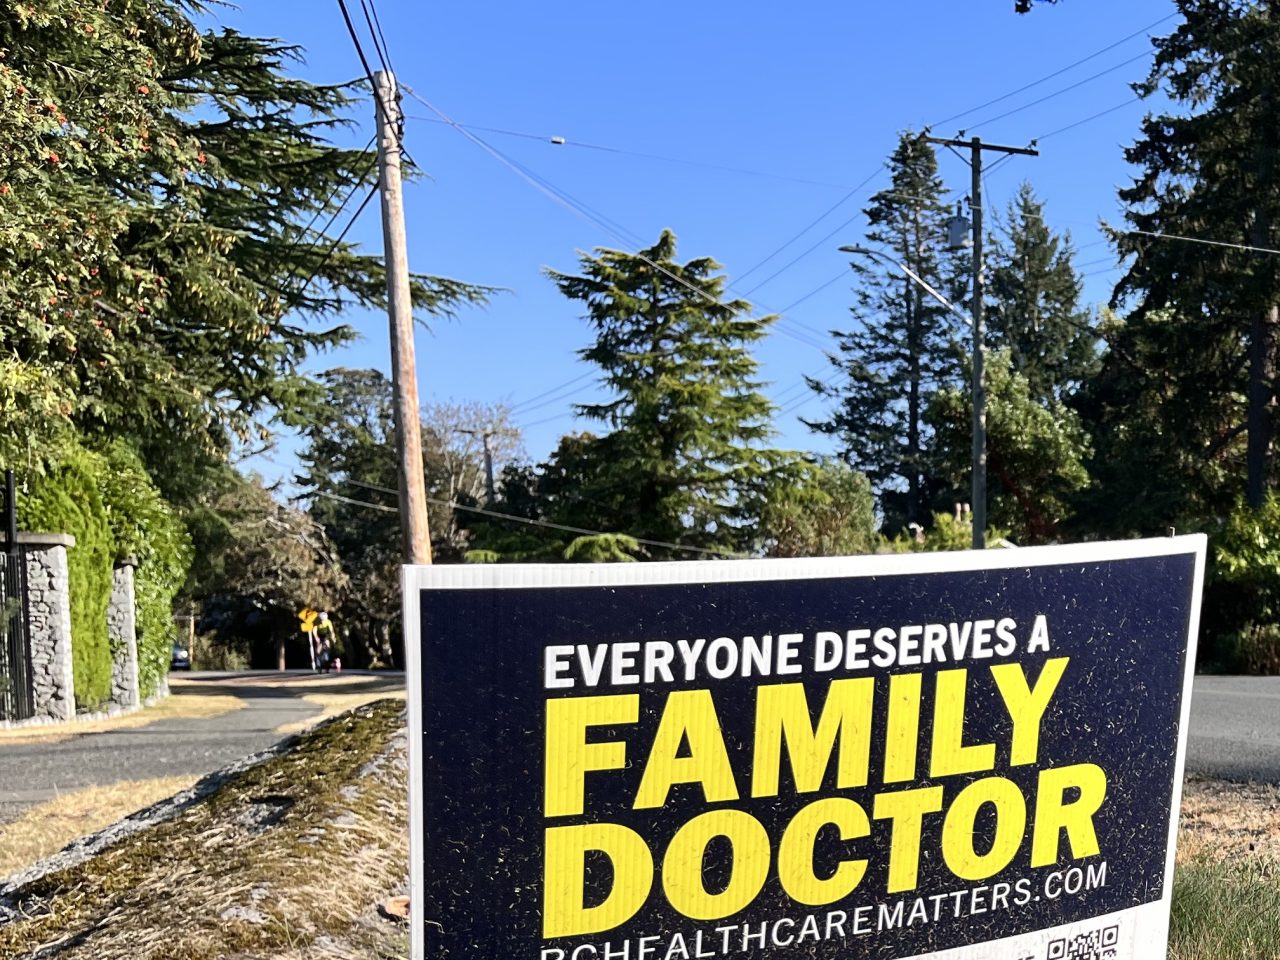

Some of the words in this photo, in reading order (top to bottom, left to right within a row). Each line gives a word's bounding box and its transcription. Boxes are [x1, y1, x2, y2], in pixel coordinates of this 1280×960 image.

[543, 633, 804, 689] EVERYONE
[814, 617, 1017, 672] DESERVES
[1028, 615, 1051, 653] A
[544, 656, 1070, 818] FAMILY
[543, 763, 1107, 939] DOCTOR
